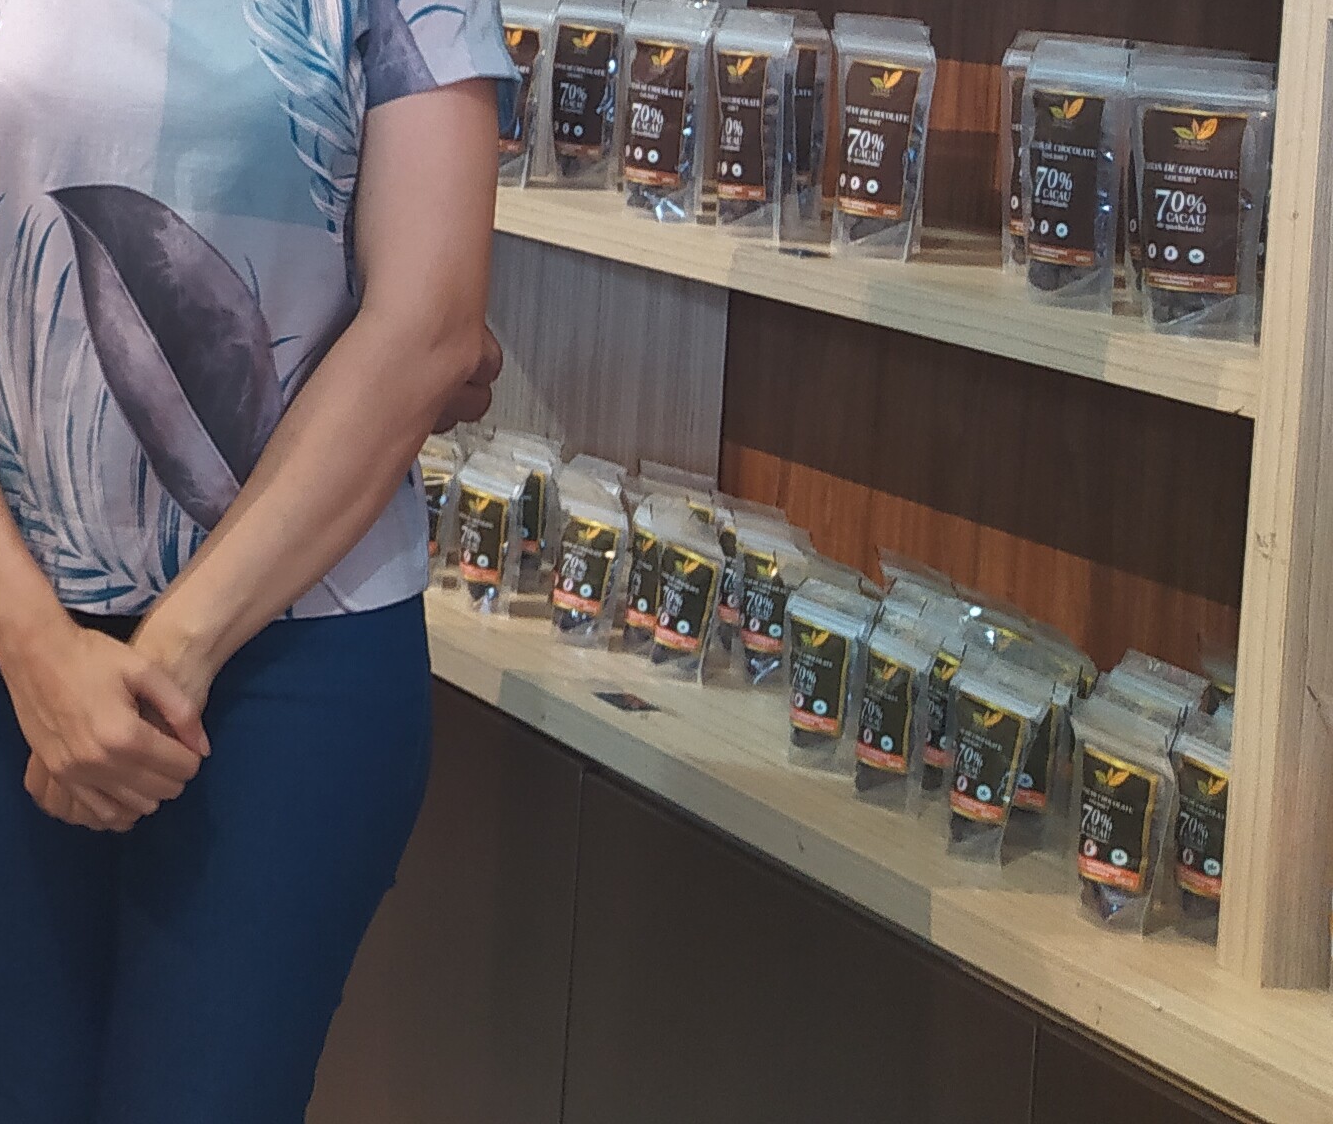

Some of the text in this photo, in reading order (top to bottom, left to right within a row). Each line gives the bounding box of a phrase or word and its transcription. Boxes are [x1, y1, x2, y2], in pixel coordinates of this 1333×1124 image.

[632, 102, 664, 132] 70%
[847, 127, 884, 161] 70%
[1034, 166, 1073, 197] 70%
[1155, 189, 1207, 222] 70%
[1165, 212, 1207, 226] CACAU
[1082, 803, 1113, 832] 70%
